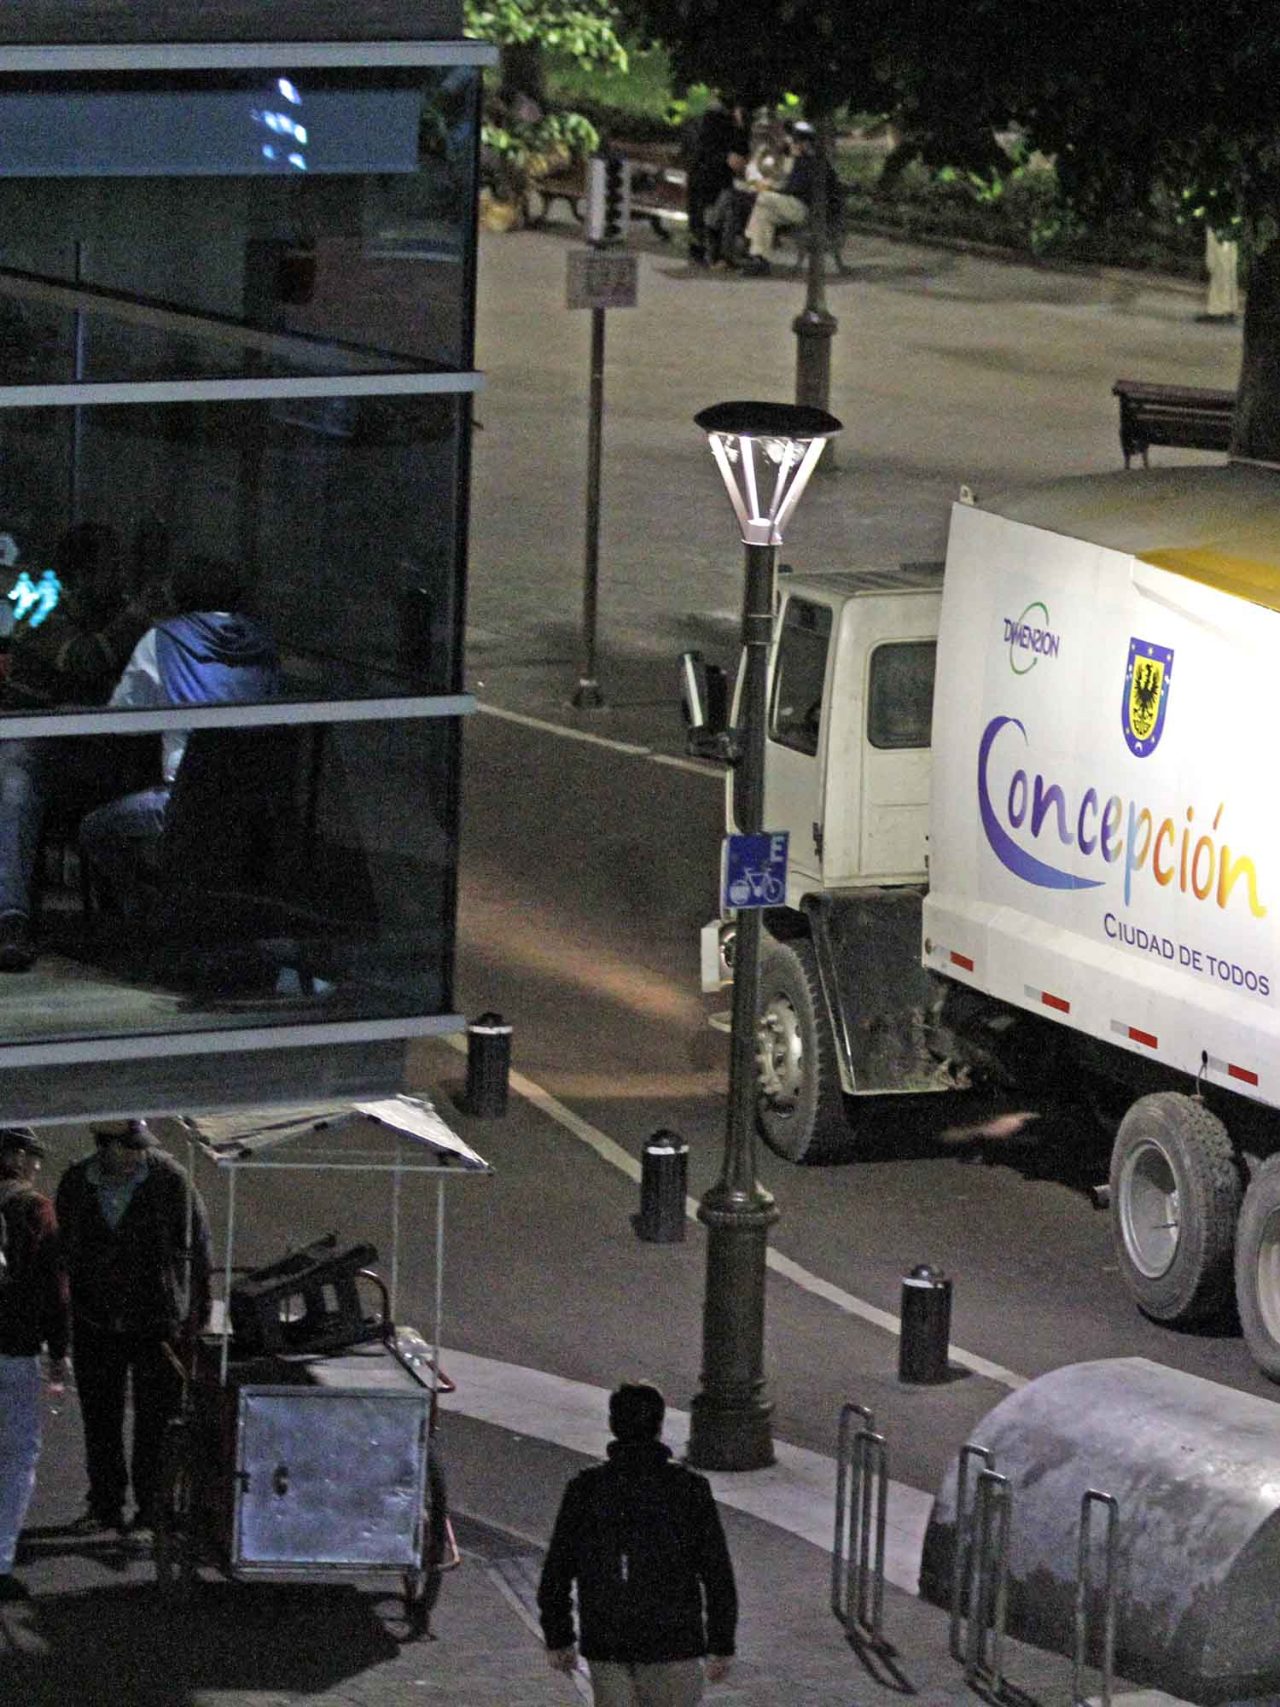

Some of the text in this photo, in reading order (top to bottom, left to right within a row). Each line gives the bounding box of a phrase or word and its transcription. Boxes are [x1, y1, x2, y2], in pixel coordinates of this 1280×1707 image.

[770, 836, 785, 862] E
[977, 715, 1268, 919] Concepción
[1103, 912, 1271, 996] CIUDAD DE TODOS
